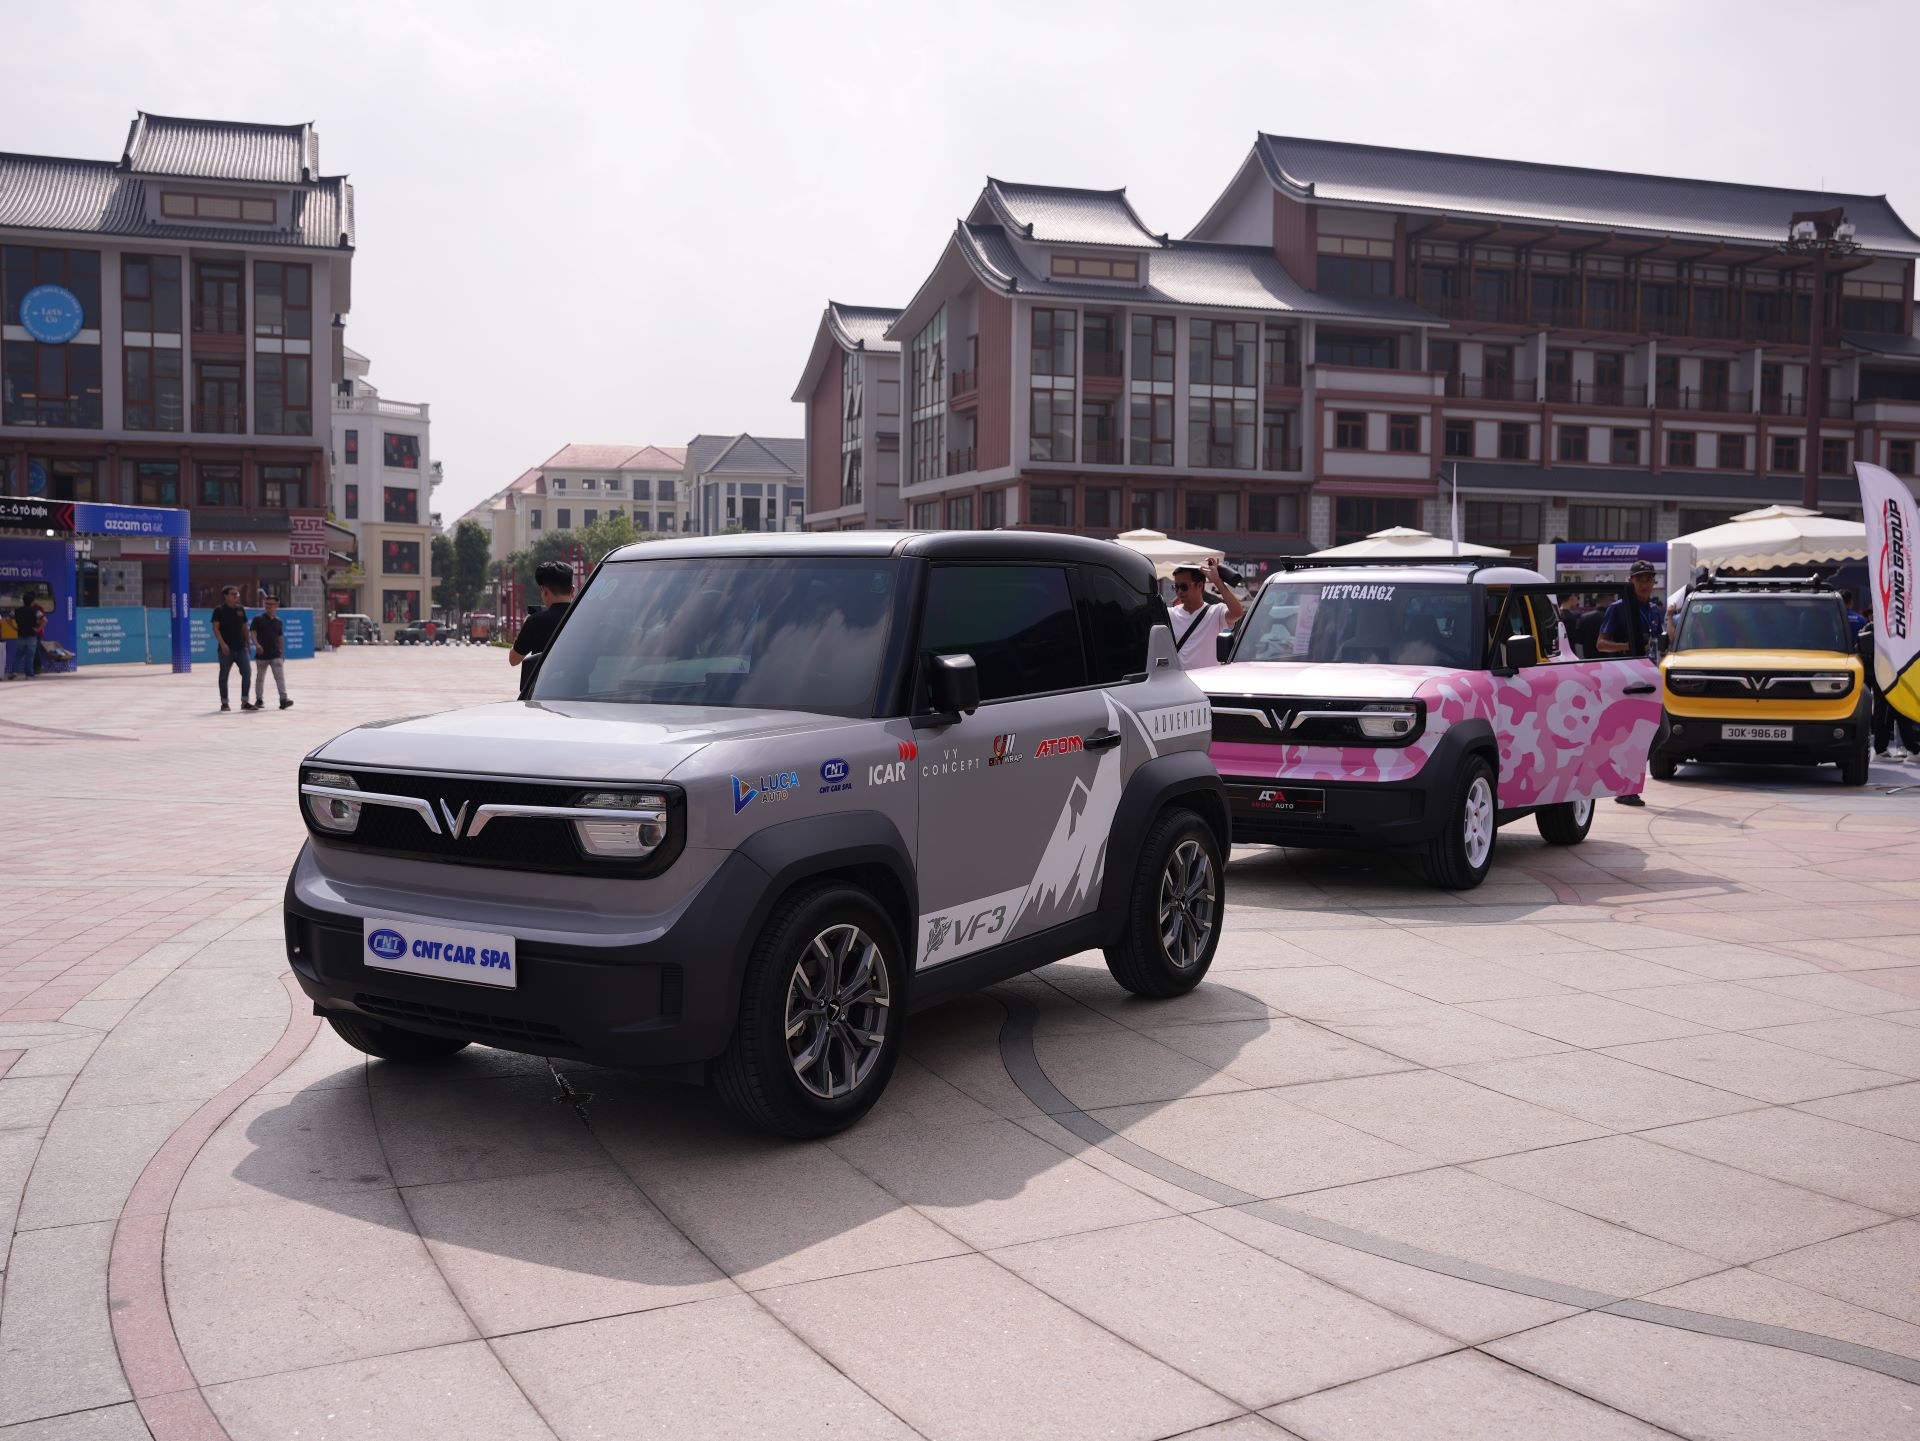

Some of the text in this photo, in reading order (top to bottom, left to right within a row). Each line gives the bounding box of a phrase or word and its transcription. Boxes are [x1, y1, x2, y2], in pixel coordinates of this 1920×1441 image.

[104, 519, 141, 531] azcam
[154, 539, 257, 552] LTERIA
[1888, 498, 1906, 640] CHUNG GROUP
[1320, 584, 1396, 601] VIETGANGZ
[1033, 734, 1084, 759] ATOM
[824, 762, 845, 778] CNT
[868, 761, 906, 786] ICAR
[922, 758, 980, 777] CONCEPT
[760, 771, 800, 792] LUCA
[761, 790, 789, 803] AUTO
[955, 905, 1007, 946] VF3
[373, 934, 402, 951] CNT
[412, 939, 511, 970] CNT CAR SPA
